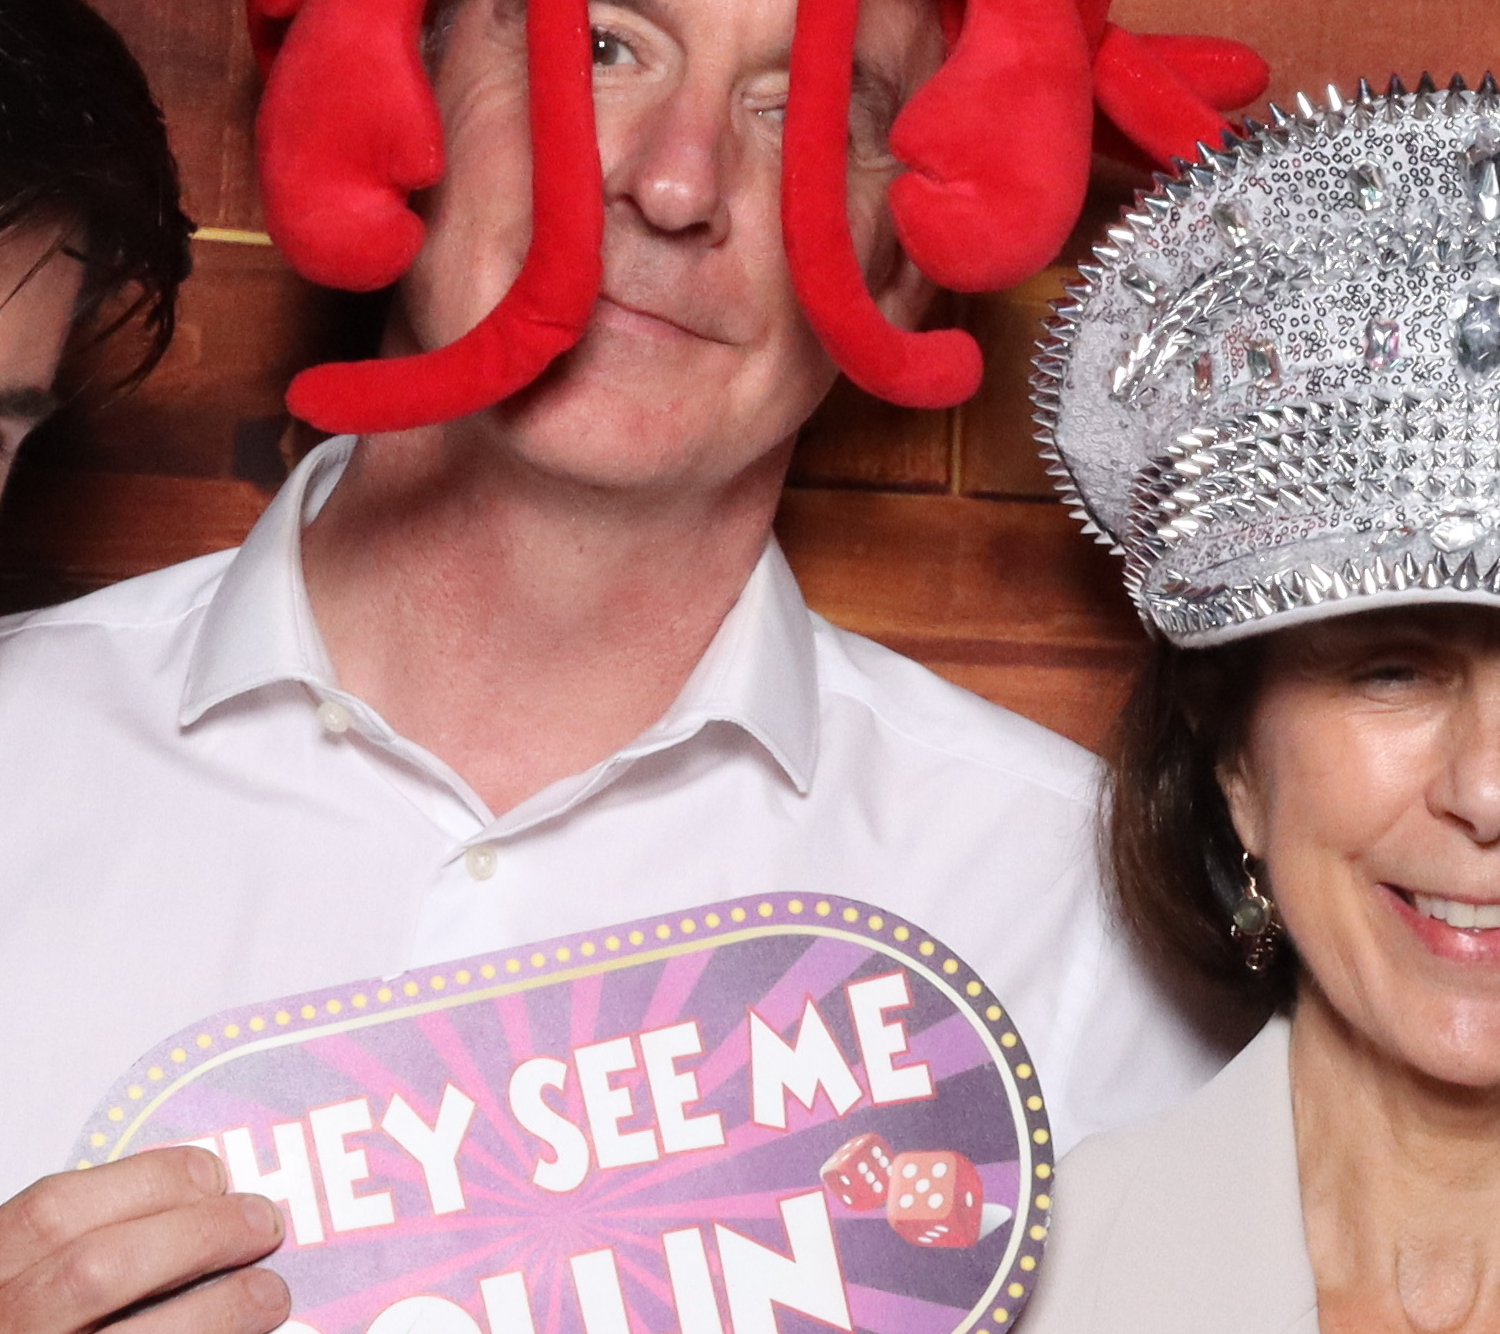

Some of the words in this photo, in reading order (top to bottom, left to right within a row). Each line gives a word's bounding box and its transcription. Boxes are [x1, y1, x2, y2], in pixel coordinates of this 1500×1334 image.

[140, 1079, 477, 1248] HEY
[505, 1019, 724, 1196] SEE
[746, 970, 935, 1132] ME
